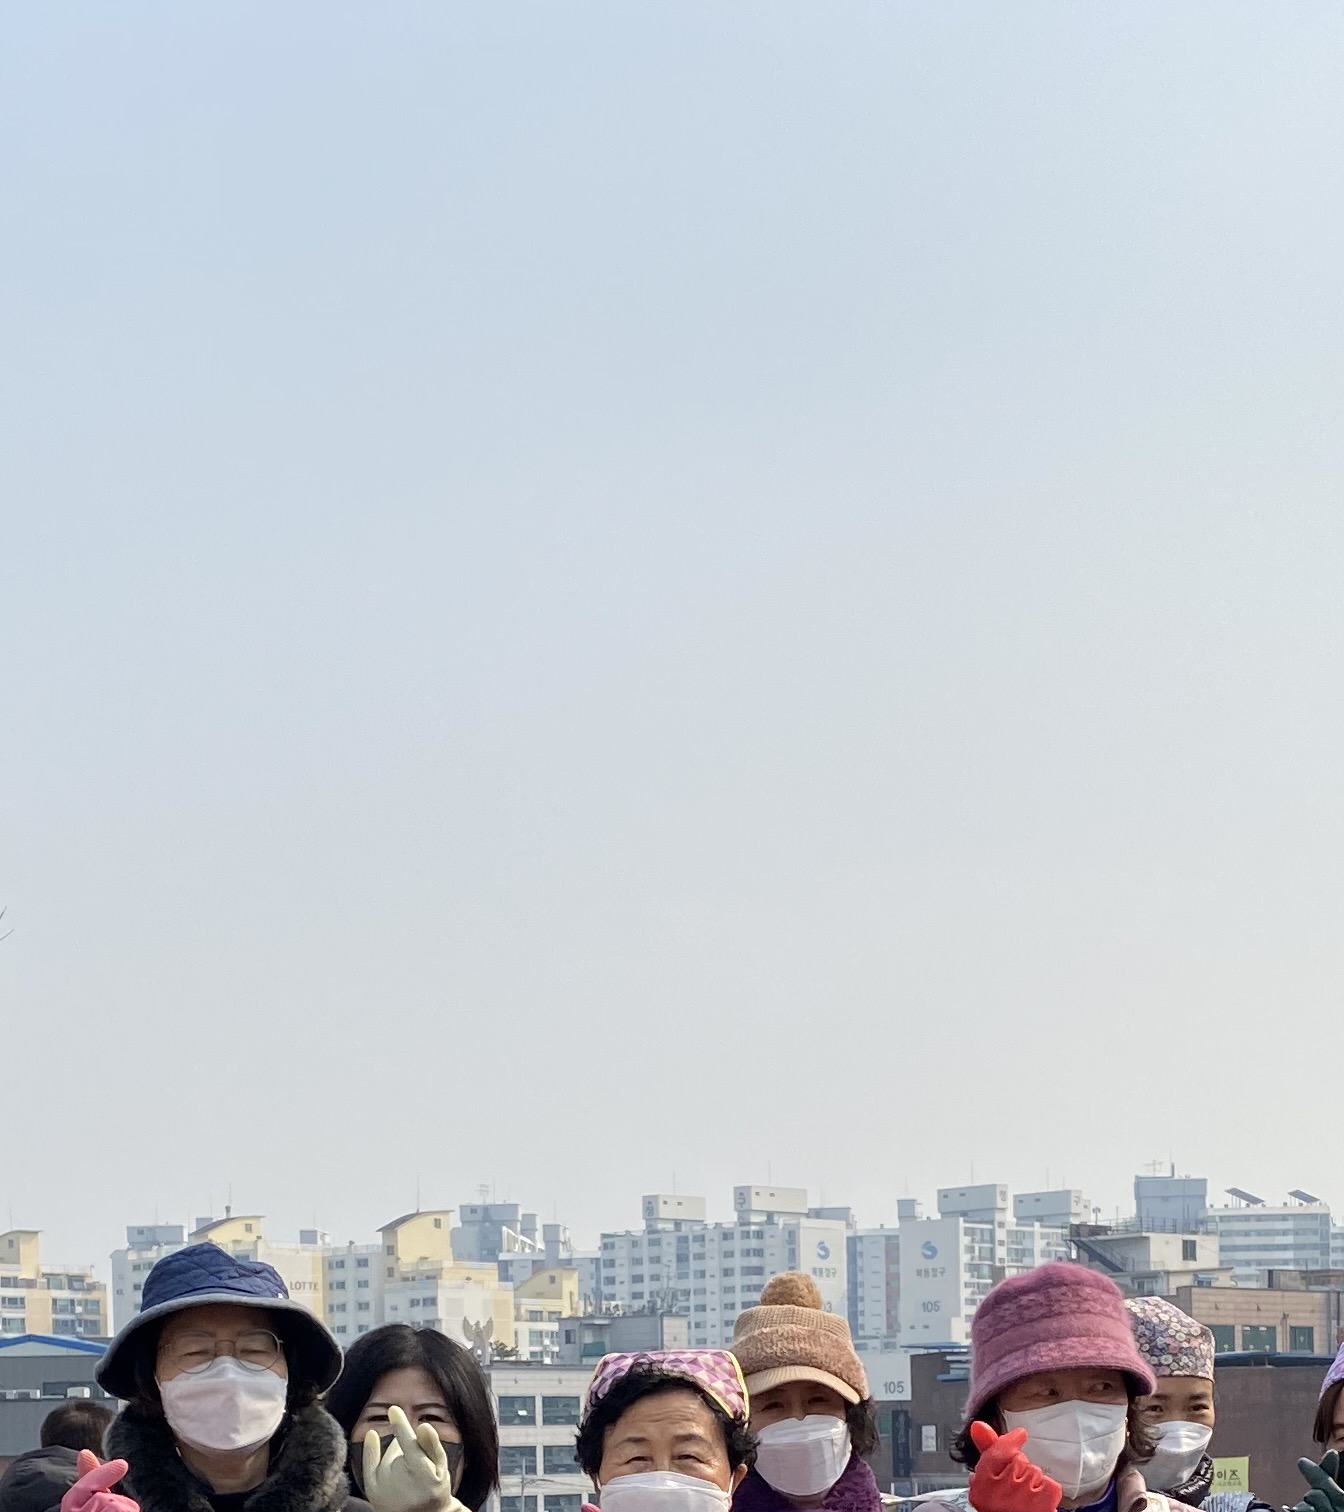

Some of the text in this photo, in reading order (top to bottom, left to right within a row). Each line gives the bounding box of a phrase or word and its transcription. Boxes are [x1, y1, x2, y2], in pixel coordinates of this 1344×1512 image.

[289, 1281, 319, 1291] LOTTE
[922, 1301, 941, 1313] 105
[883, 1381, 905, 1394] 105
[1216, 1469, 1241, 1481] 이즈
